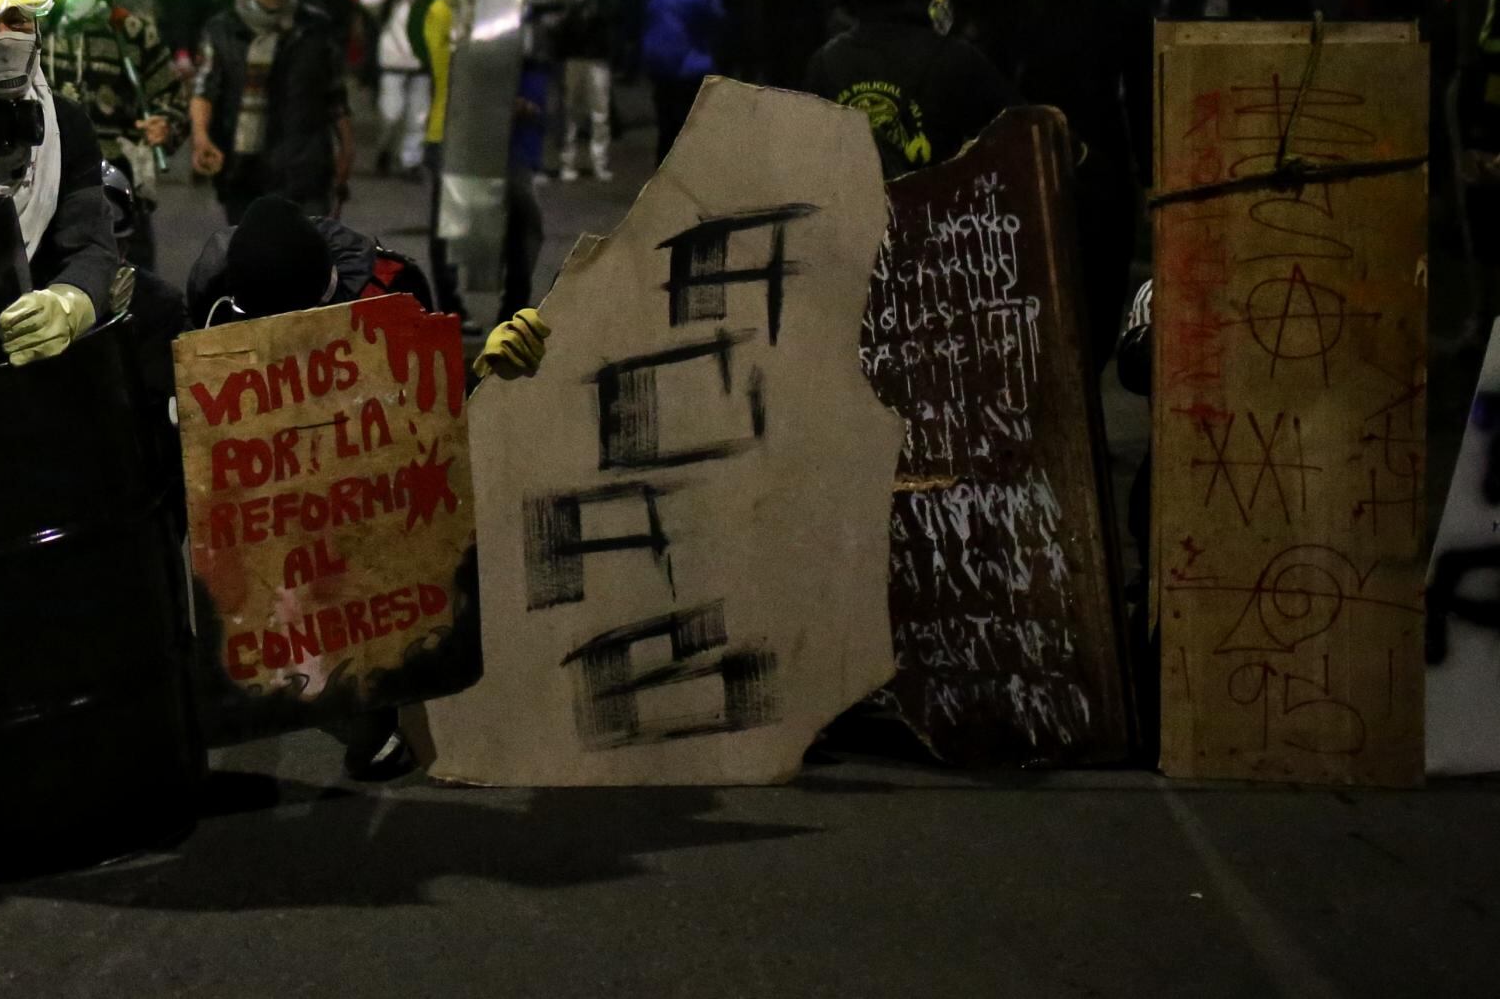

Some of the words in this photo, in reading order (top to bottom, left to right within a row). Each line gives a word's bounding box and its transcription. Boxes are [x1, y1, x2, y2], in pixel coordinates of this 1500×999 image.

[190, 340, 359, 426] VAMOS
[212, 426, 301, 491] POR
[334, 397, 393, 458] LA
[284, 540, 347, 590] AL
[227, 583, 447, 681] CONGRESO
